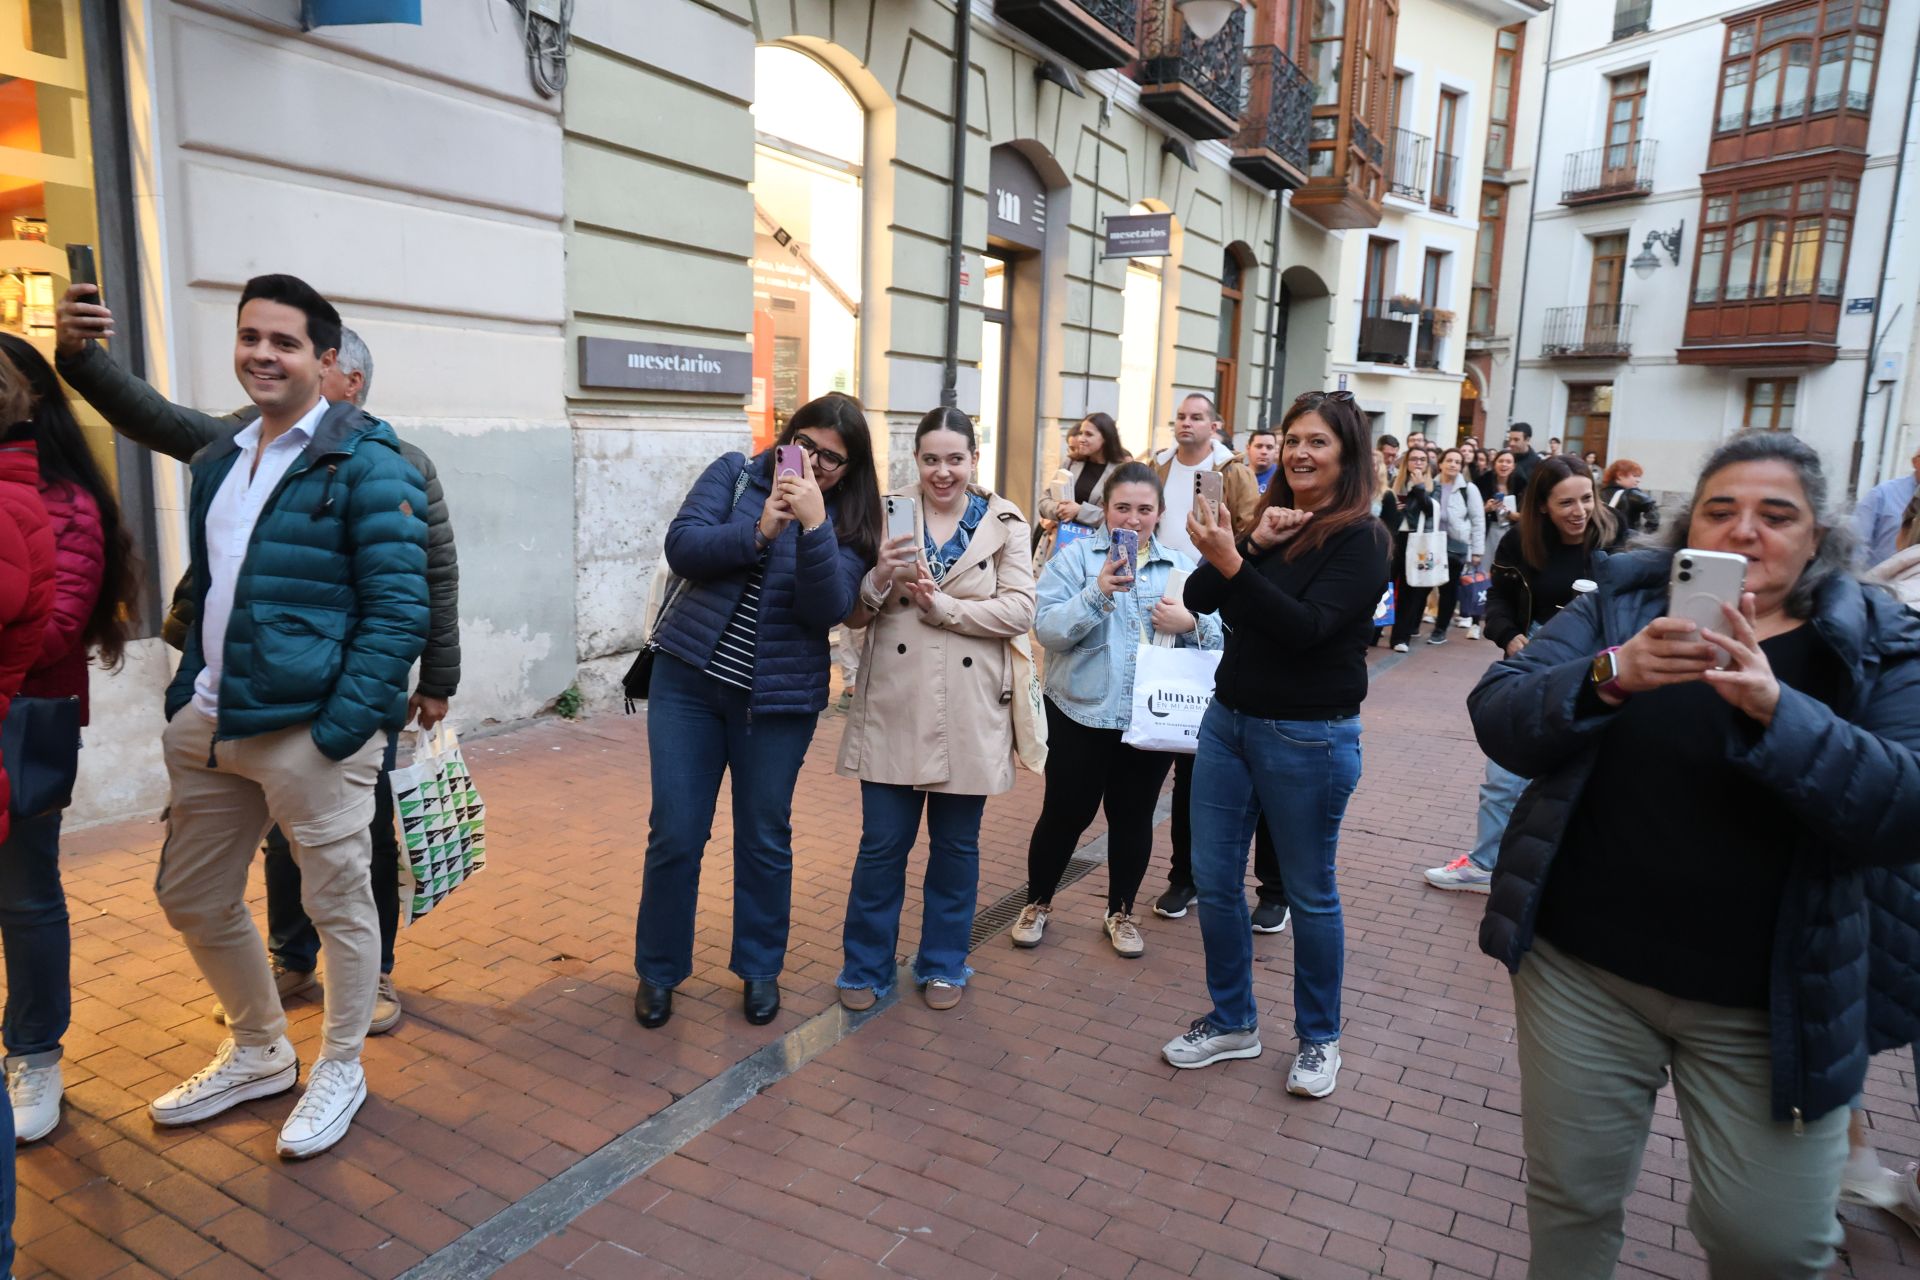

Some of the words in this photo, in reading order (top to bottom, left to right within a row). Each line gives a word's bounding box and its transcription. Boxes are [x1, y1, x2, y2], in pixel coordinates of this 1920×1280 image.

[1110, 227, 1167, 240] mesetarios
[628, 353, 722, 374] mesetarios
[1156, 701, 1167, 709] EN
